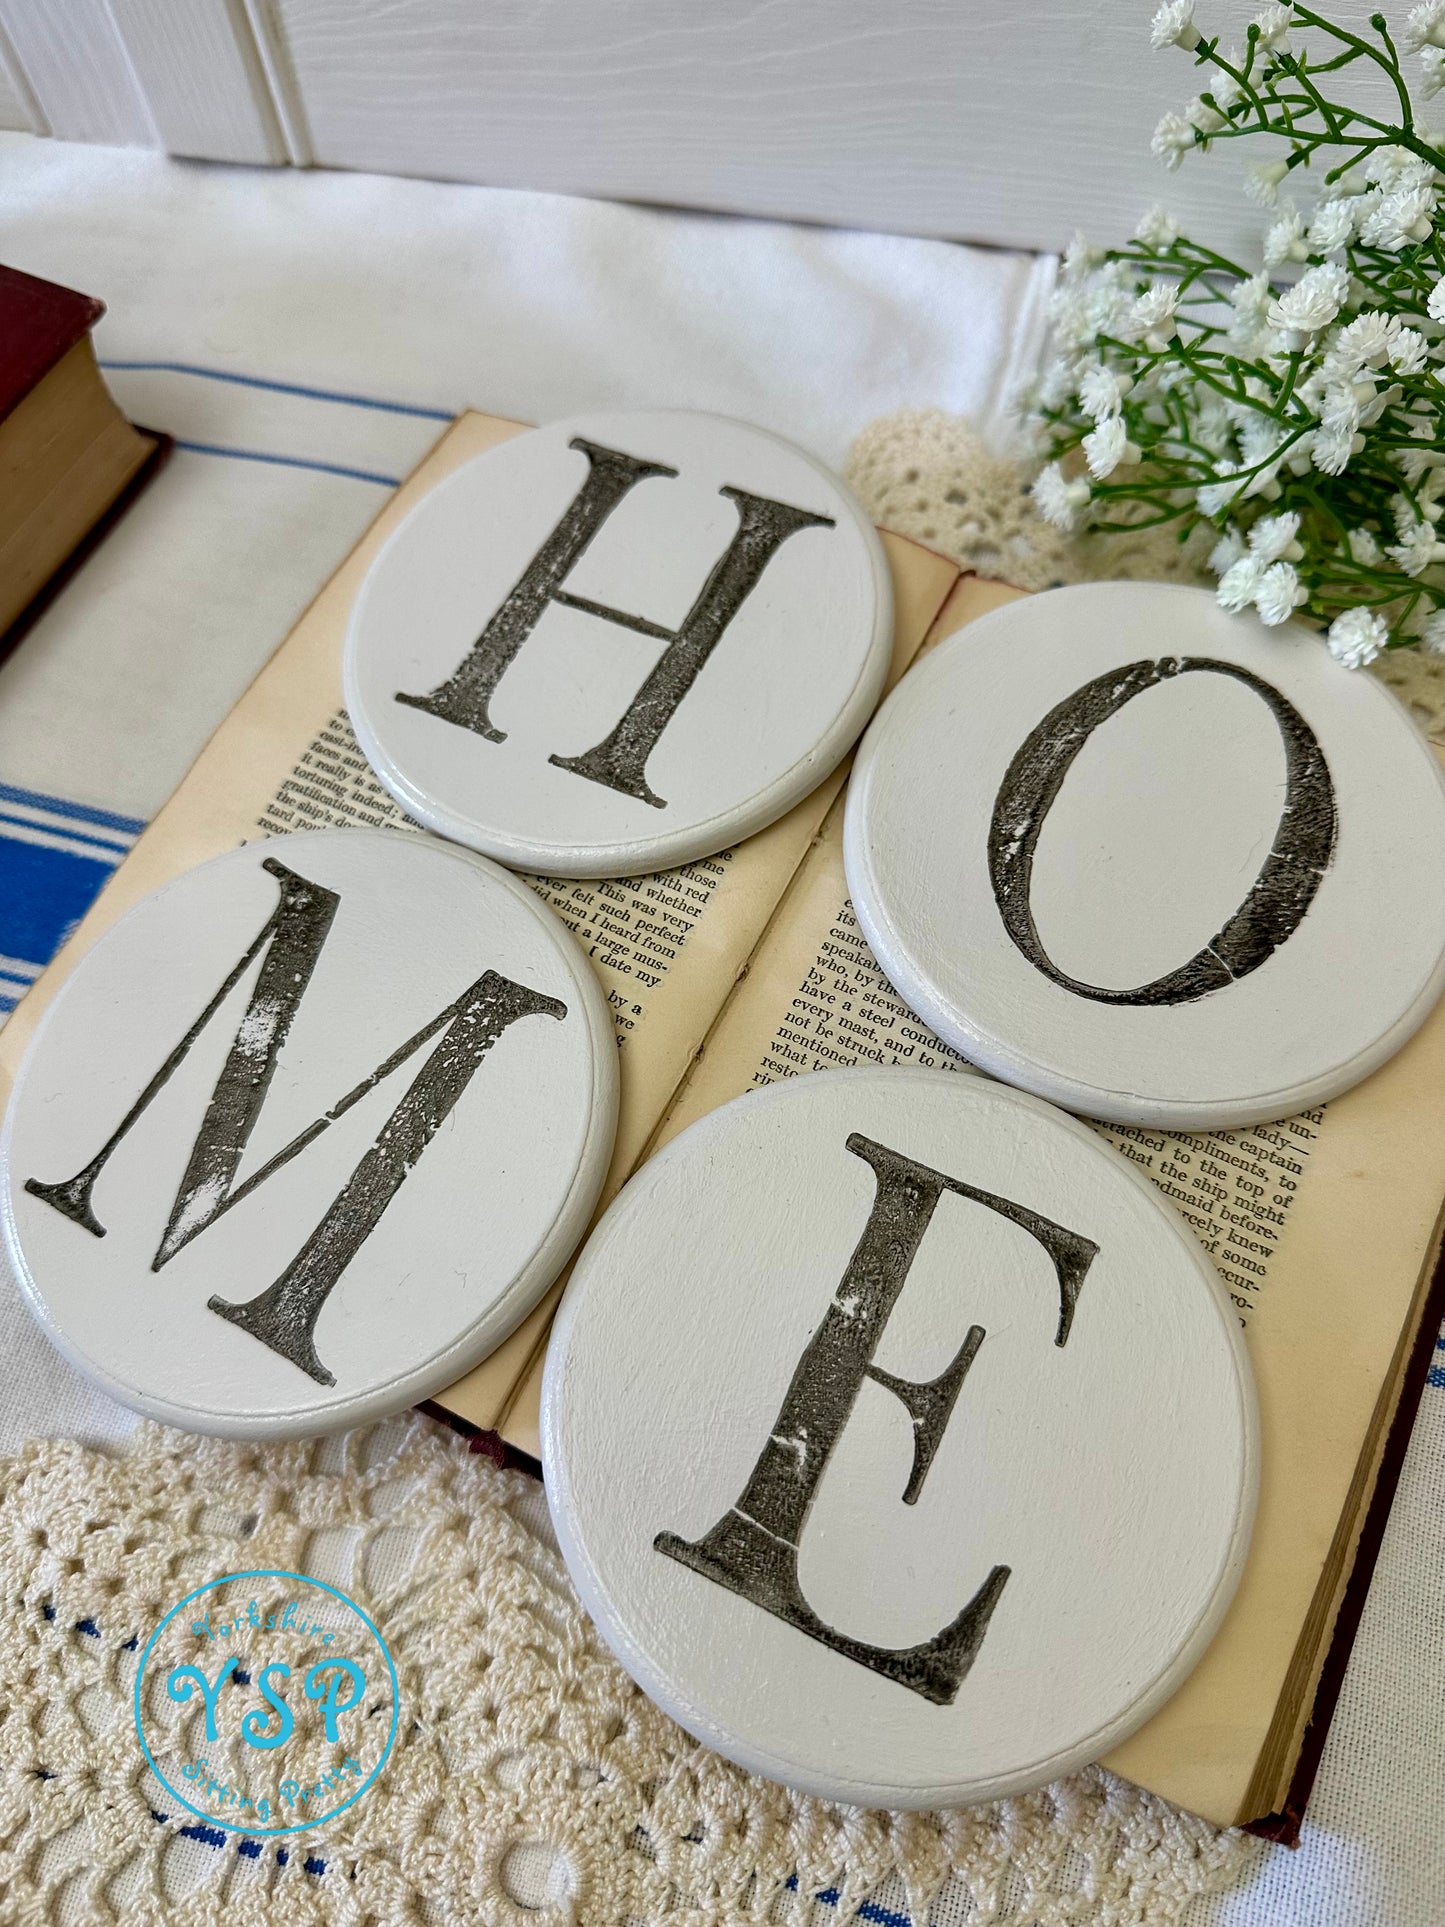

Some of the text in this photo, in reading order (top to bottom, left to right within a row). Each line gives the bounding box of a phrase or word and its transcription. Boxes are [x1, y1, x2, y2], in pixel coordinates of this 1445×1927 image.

[395, 437, 836, 809] H
[328, 719, 343, 731] to
[309, 741, 369, 771] faces and
[293, 765, 348, 798] torturing
[352, 789, 398, 819] indeed;
[315, 759, 351, 782] really
[354, 774, 365, 787] is
[368, 782, 383, 795] as
[267, 803, 296, 822] tard
[275, 791, 297, 806] the
[297, 801, 334, 823] ship's
[280, 780, 357, 816] gratification
[358, 811, 385, 828] and
[987, 656, 1340, 1007] O
[653, 873, 711, 904] with red
[680, 865, 717, 889] those
[571, 887, 595, 906] felt
[599, 902, 631, 922] such
[634, 919, 687, 946] perfect
[597, 880, 695, 934] This was very
[646, 887, 702, 918] whether
[836, 909, 857, 927] its
[553, 896, 588, 919] when
[588, 912, 602, 925] I
[599, 917, 642, 944] heard
[640, 936, 676, 960] from
[560, 915, 669, 971] ut a large mus-
[829, 927, 868, 950] came
[600, 952, 632, 974] date
[635, 969, 662, 988] my
[816, 955, 849, 979] who,
[854, 969, 875, 988] by
[821, 941, 885, 975] speakab
[607, 989, 642, 1016] by a
[807, 966, 928, 1027] by the steward
[615, 1014, 635, 1030] we
[784, 1012, 812, 1030] not
[815, 1021, 834, 1039] be
[837, 1034, 886, 1065] struck
[792, 997, 834, 1023] every
[838, 1016, 878, 1044] mast,
[884, 1037, 916, 1057] and
[918, 1051, 935, 1068] to
[799, 981, 836, 1004] have
[841, 1000, 852, 1012] a
[858, 1007, 896, 1029] steel
[900, 1026, 974, 1066] conducto
[770, 1041, 808, 1066] what
[776, 1026, 859, 1067] mentioned
[24, 856, 568, 1388] M
[1288, 1121, 1318, 1139] un-
[1298, 1109, 1324, 1125] nd
[1239, 1140, 1302, 1176] captain
[1119, 1142, 1287, 1226] that the ship might
[1172, 1147, 1191, 1164] to
[1199, 1159, 1228, 1181] the
[1235, 1175, 1265, 1199] top
[1271, 1193, 1295, 1209] of
[1278, 1174, 1298, 1192] to
[1176, 1207, 1275, 1259] rcely knew
[1218, 1204, 1279, 1241] before-
[1200, 1239, 1268, 1276] of some
[654, 1132, 1101, 1706] E
